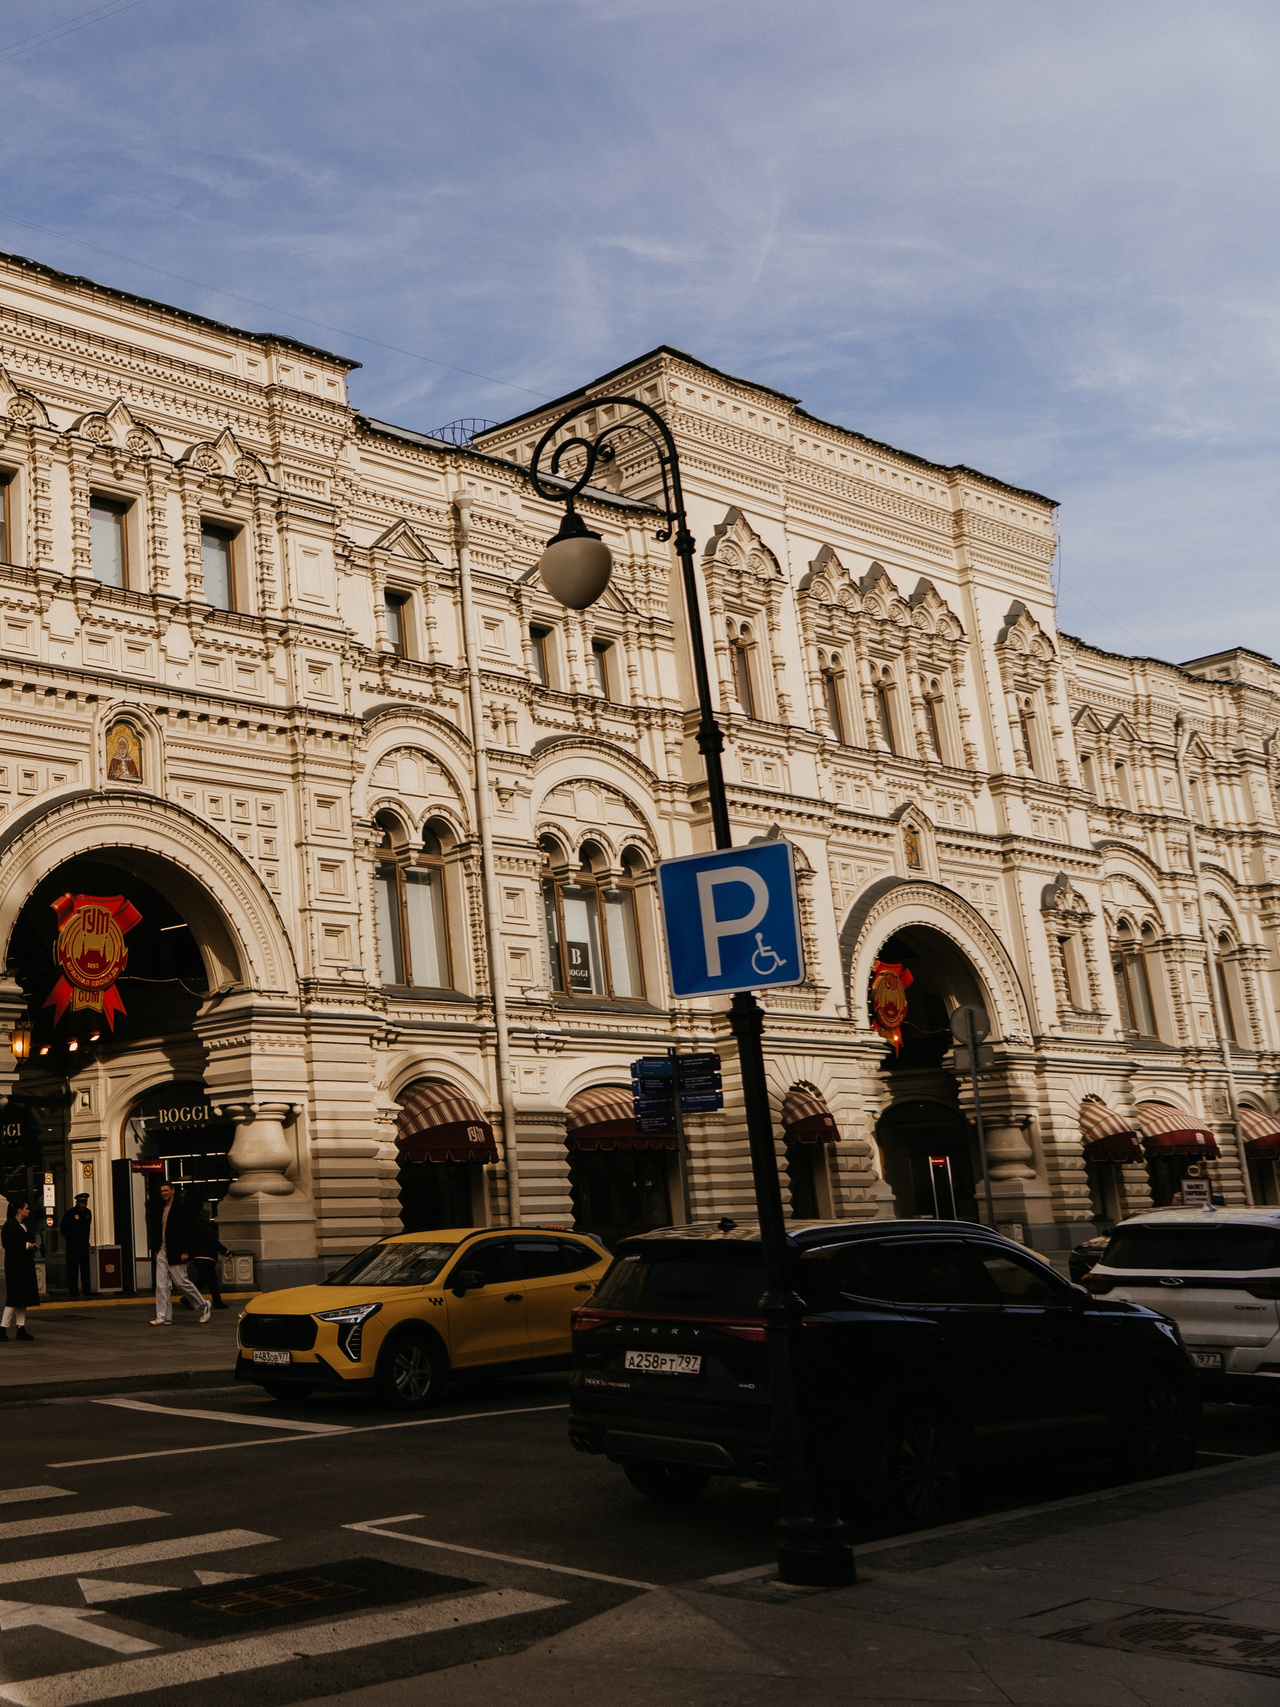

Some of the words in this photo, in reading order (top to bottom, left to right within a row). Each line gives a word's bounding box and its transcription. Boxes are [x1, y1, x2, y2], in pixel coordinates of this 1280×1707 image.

[82, 908, 110, 935] ГУМ
[695, 865, 770, 978] P
[571, 948, 582, 964] B
[66, 961, 90, 987] КРАСНАЯ
[90, 967, 119, 987] ПЛОЩАДЬ
[569, 969, 588, 977] OGGI
[78, 990, 100, 1003] GUM
[158, 1105, 210, 1124] BOGGI
[2, 1122, 23, 1138] GGI
[466, 1125, 486, 1144] ГУМ
[615, 1325, 700, 1336] CHERY
